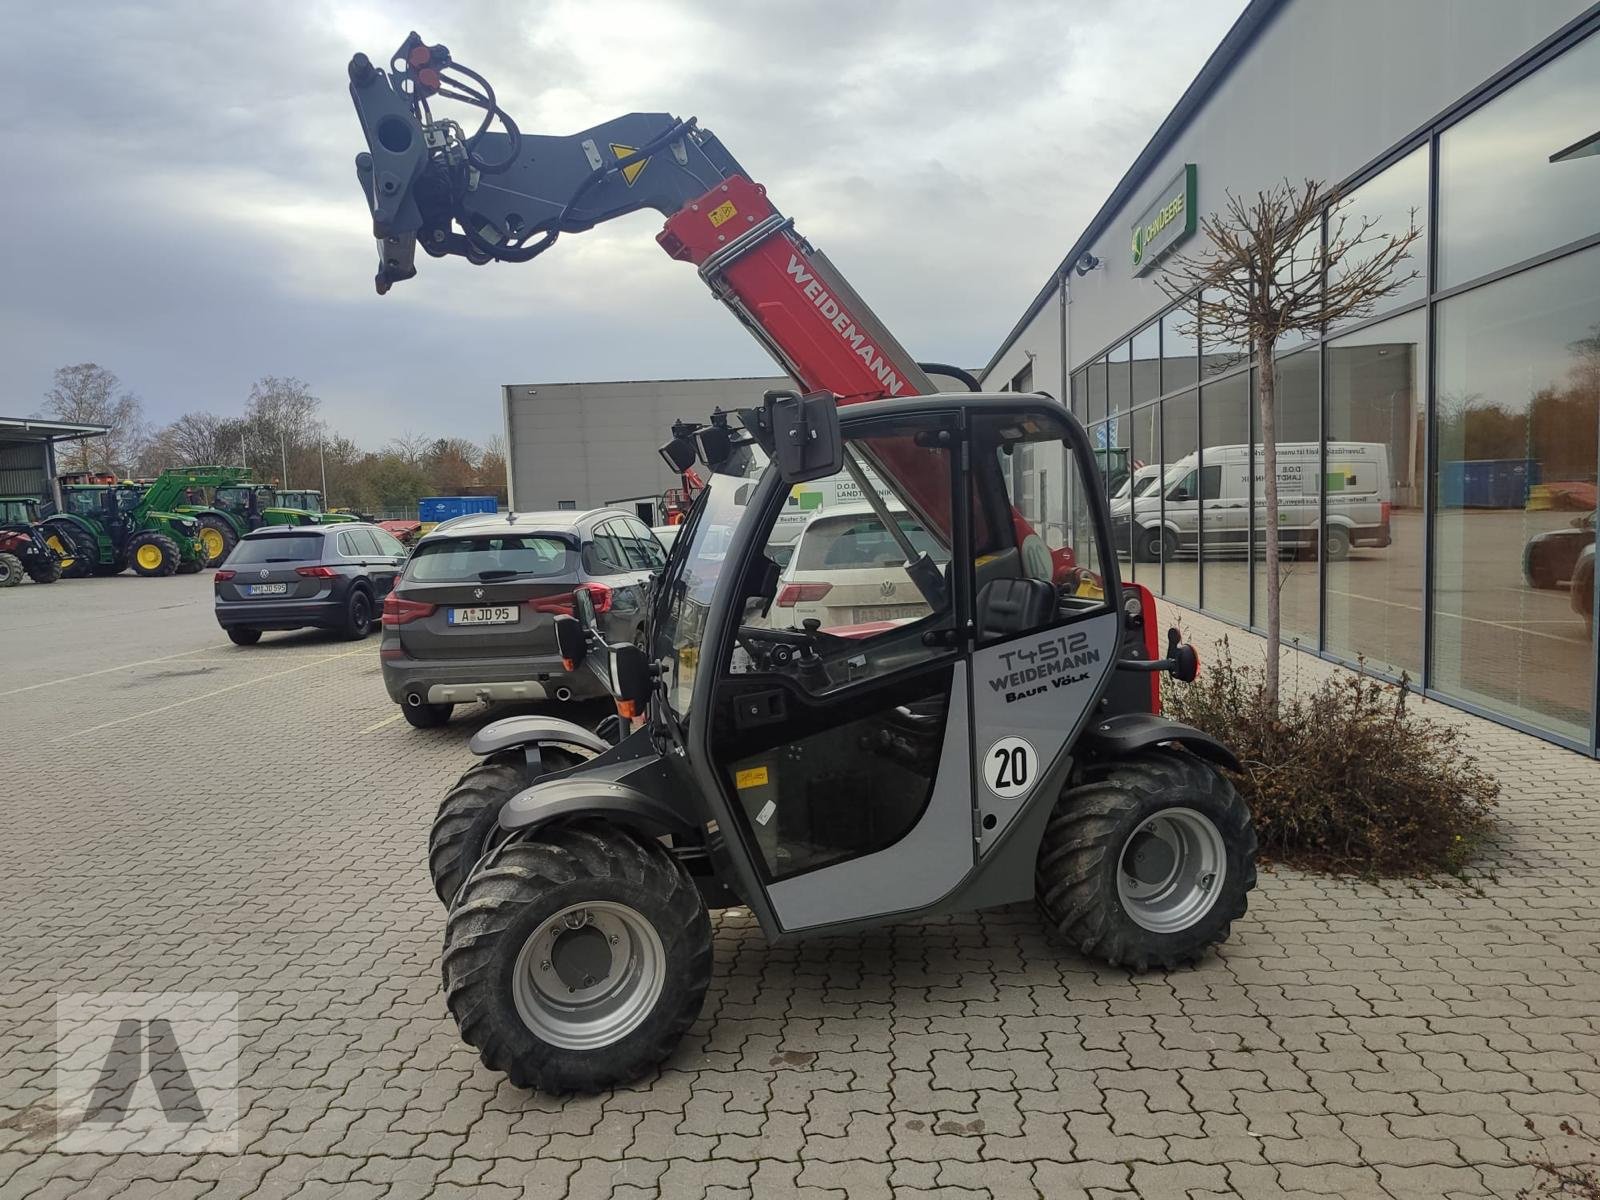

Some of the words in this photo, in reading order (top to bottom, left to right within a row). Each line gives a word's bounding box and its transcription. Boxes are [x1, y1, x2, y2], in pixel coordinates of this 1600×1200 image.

[1160, 192, 1185, 230] DEERE
[785, 254, 904, 396] WEIDEMANN
[461, 609, 469, 621] A
[477, 608, 492, 621] JD
[494, 607, 509, 620] 95
[988, 648, 1100, 692] WEIDEMANN
[998, 631, 1089, 671] T4512
[994, 746, 1027, 789] 20
